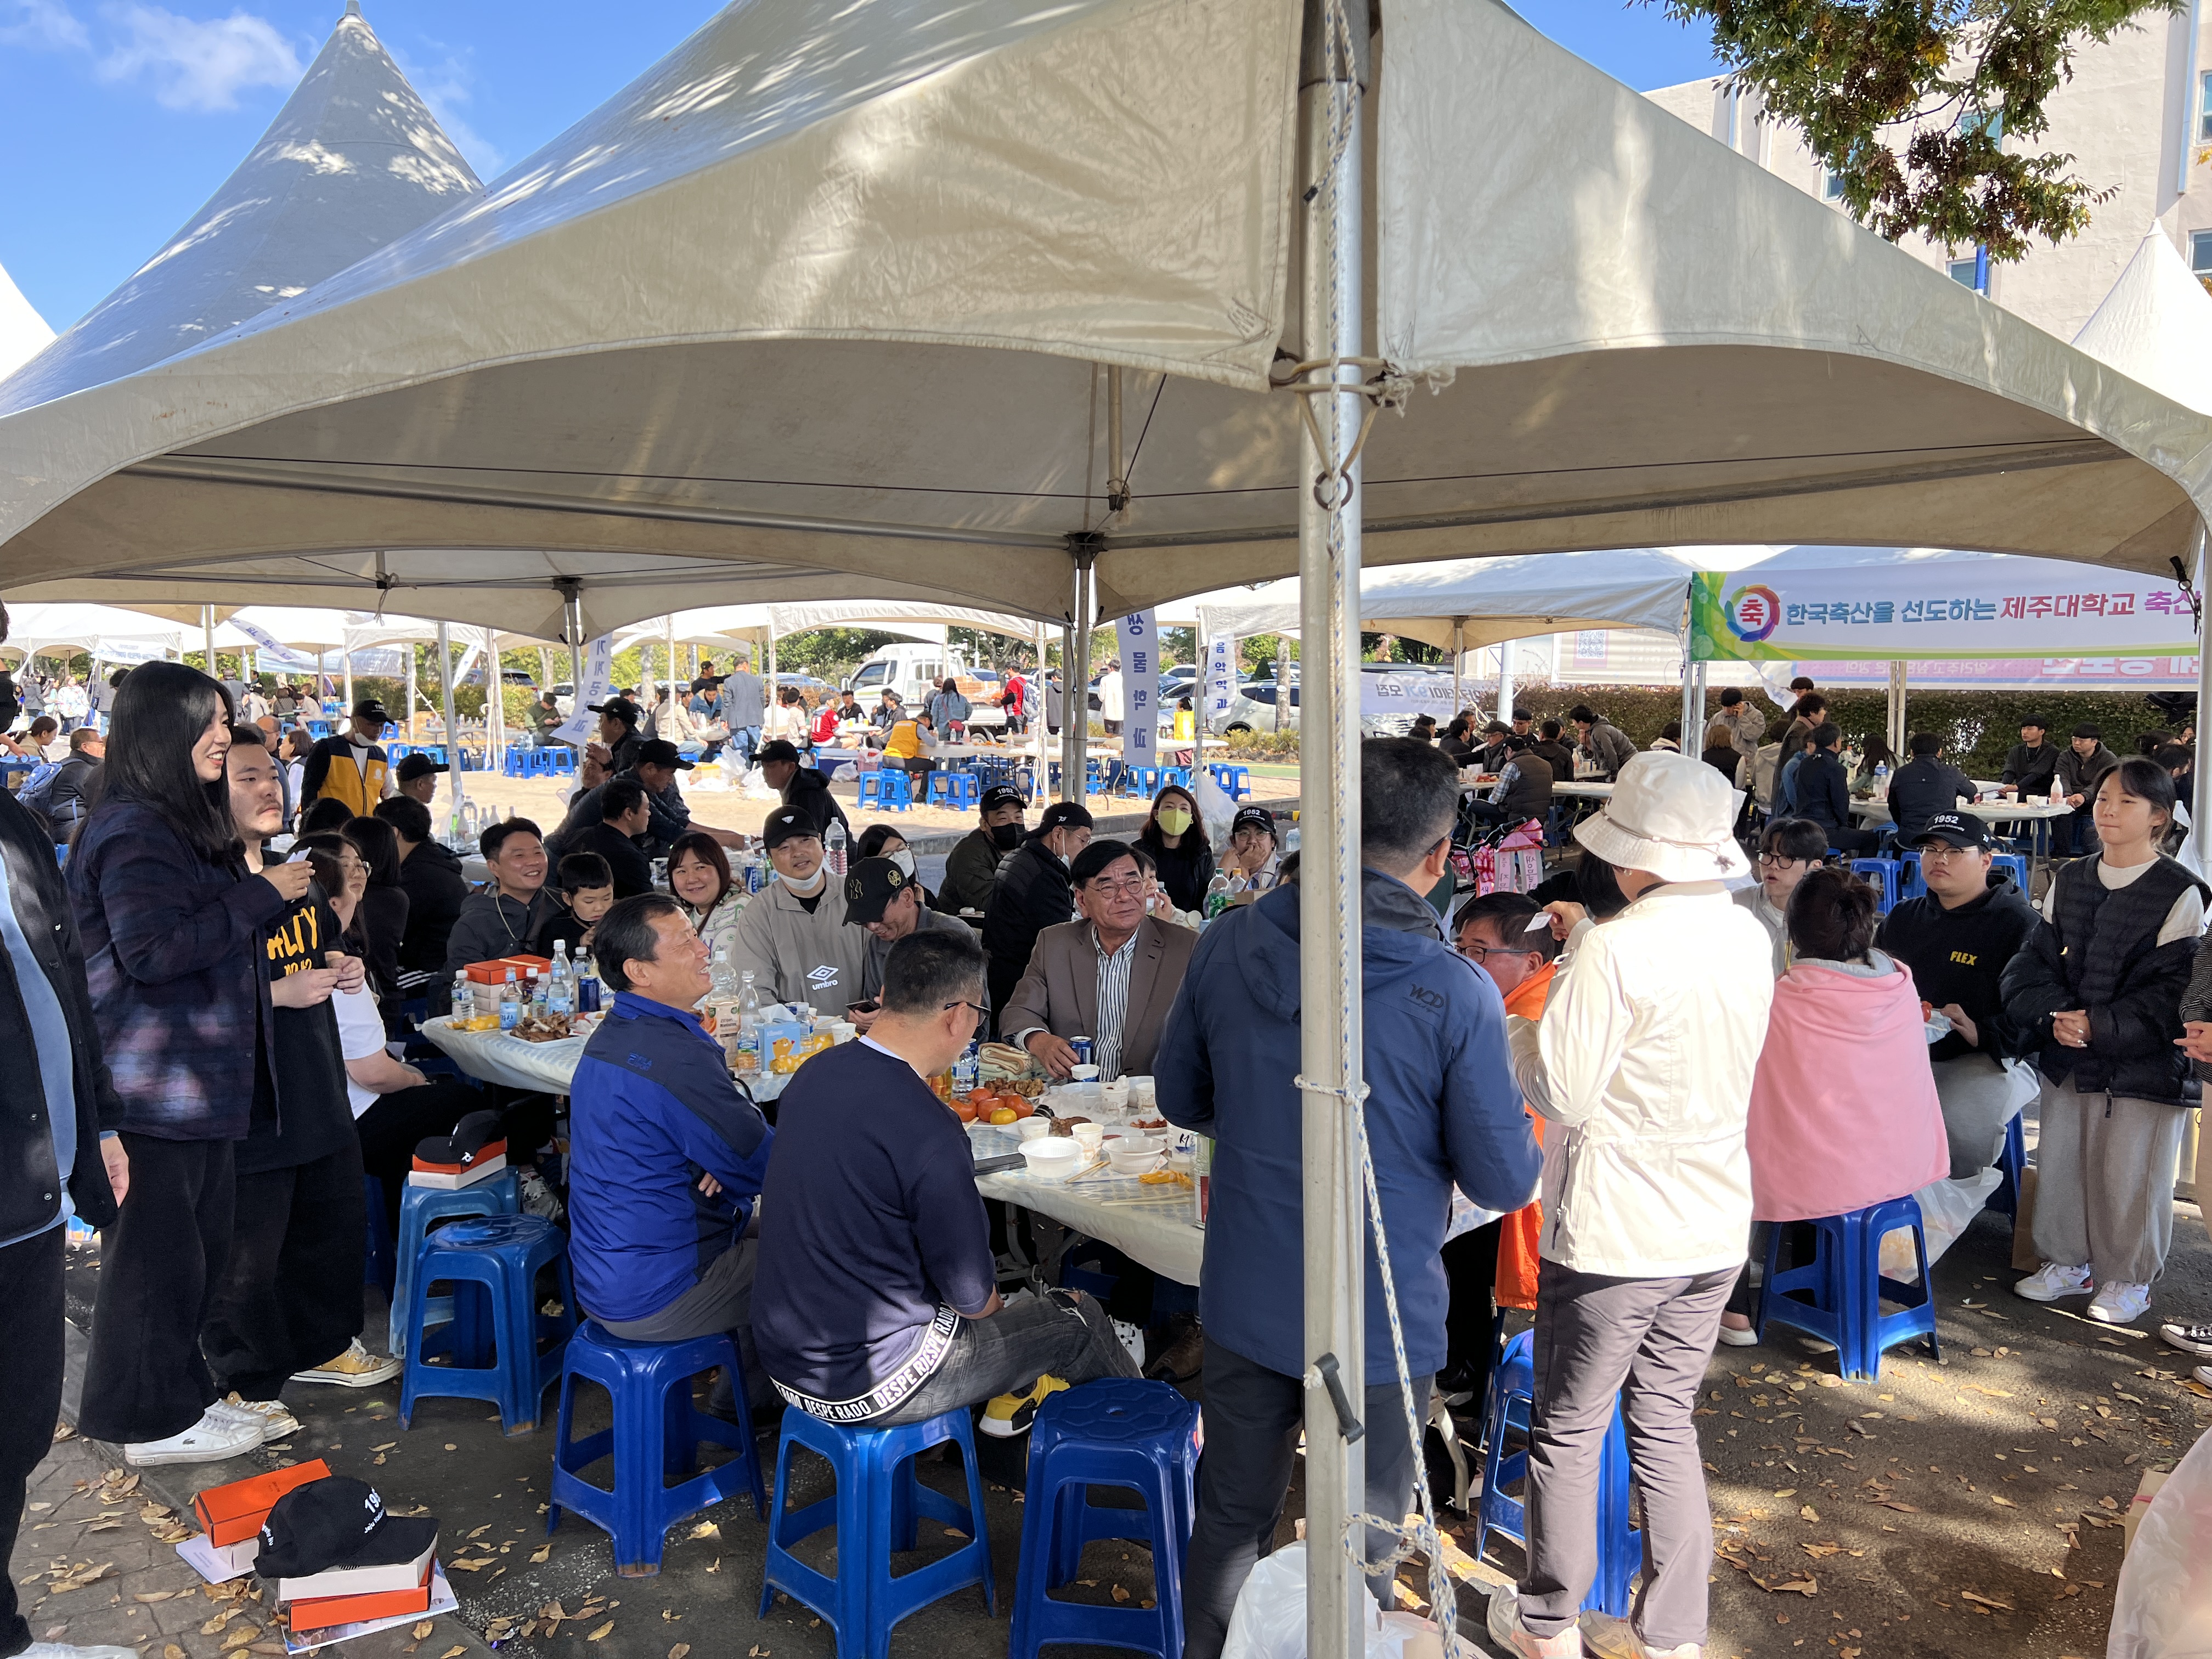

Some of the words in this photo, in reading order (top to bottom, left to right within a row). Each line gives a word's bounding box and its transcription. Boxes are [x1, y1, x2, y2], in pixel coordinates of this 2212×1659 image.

[1739, 599, 1764, 625] 축
[1786, 601, 1894, 625] 한국축산을
[1900, 598, 1996, 623] 선도하는
[2000, 592, 2135, 619] 제주대학교
[1215, 641, 1228, 709] 음악학과
[1934, 815, 1959, 824] 1952
[1950, 951, 1978, 966] FLEX
[812, 979, 838, 990] umbro
[804, 1398, 838, 1420] DESPE
[835, 1400, 872, 1420] RADO
[873, 1368, 918, 1408] DESPE
